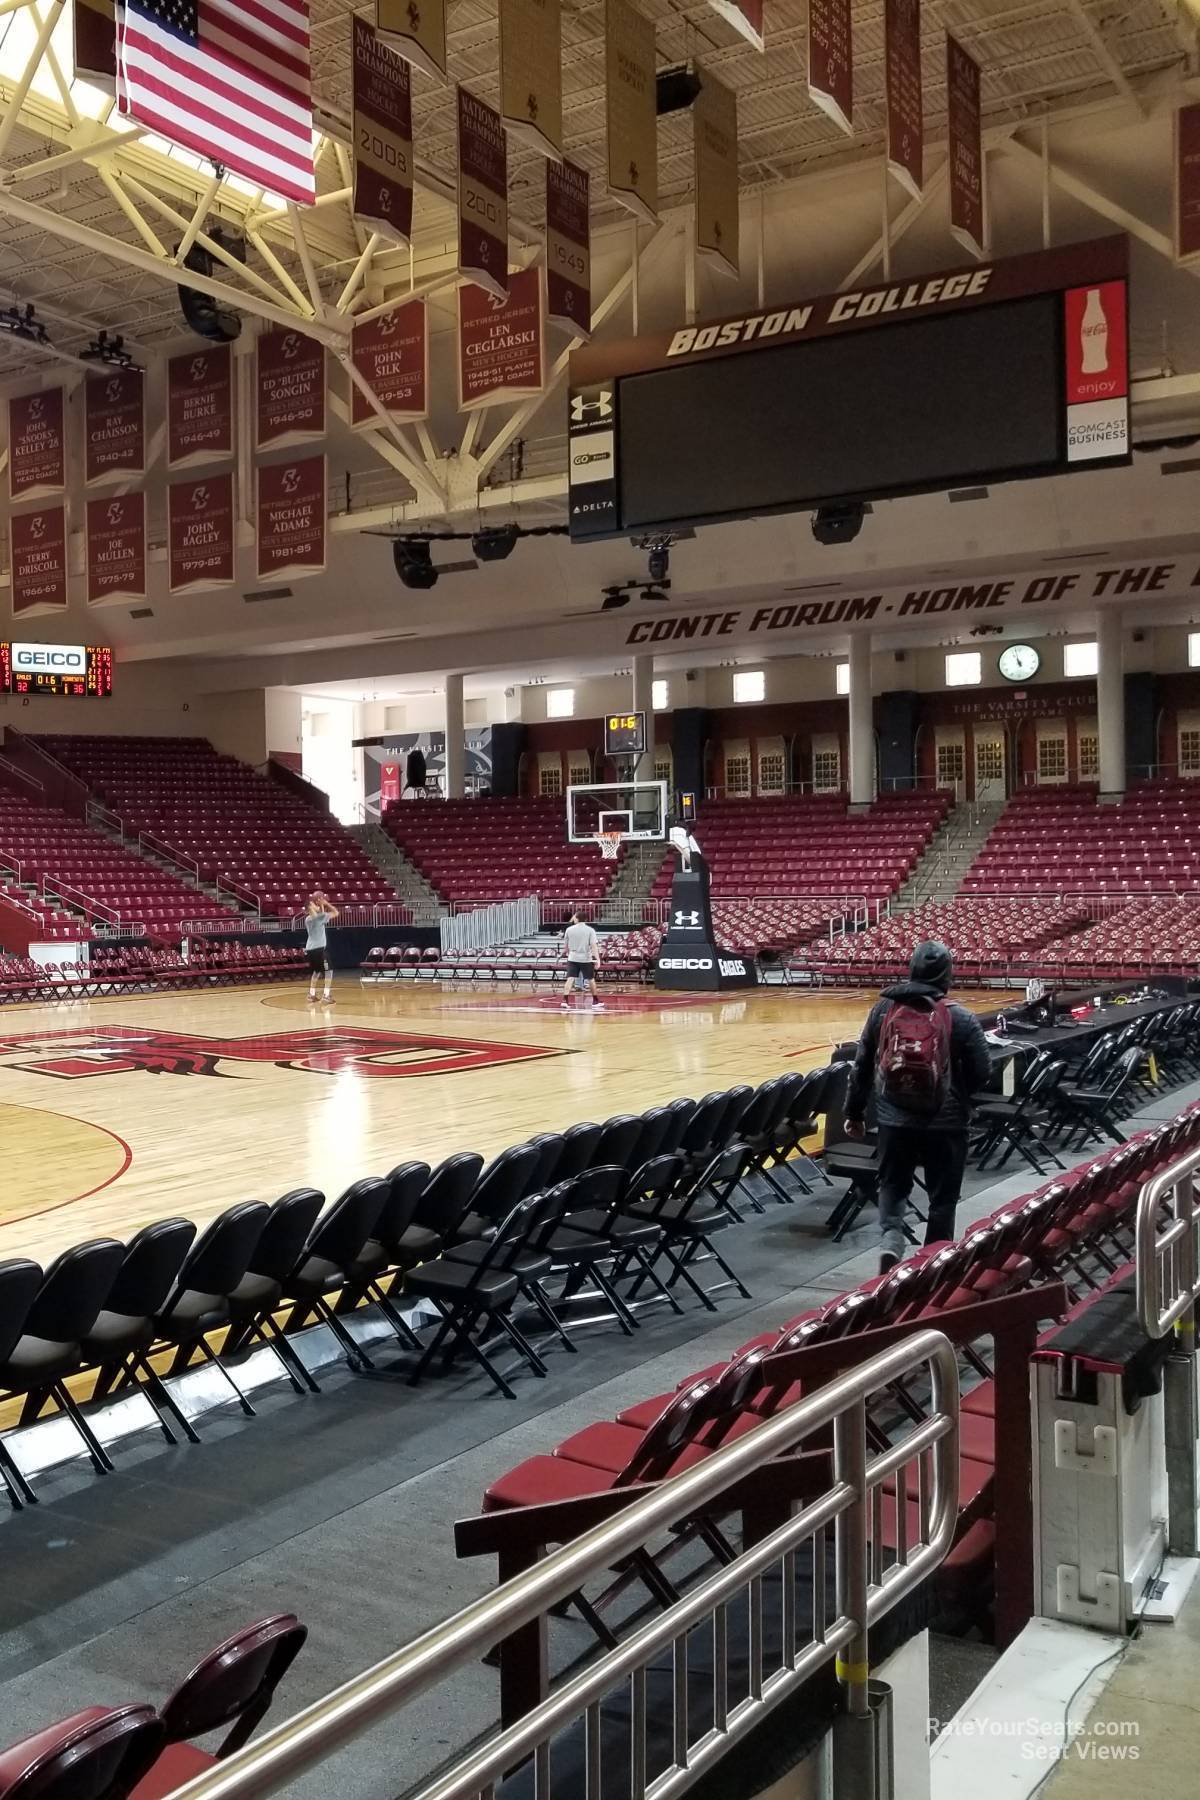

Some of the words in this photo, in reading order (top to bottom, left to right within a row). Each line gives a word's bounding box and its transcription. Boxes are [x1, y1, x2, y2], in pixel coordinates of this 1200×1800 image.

[357, 27, 408, 74] NATIONAL
[356, 47, 408, 90] CHAMPIONS
[361, 129, 406, 173] 2008
[554, 243, 585, 274] 1949
[464, 315, 500, 329] RETIRED
[502, 306, 536, 320] JERSEY
[667, 306, 813, 357] BOSTON
[828, 269, 993, 325] COLLEGE
[489, 324, 510, 339] LEN
[466, 330, 536, 356] CEGLARSKI
[374, 350, 402, 366] JOHN
[504, 360, 535, 372] PLAYER
[375, 363, 400, 378] SILK
[507, 369, 535, 381] COACH
[263, 379, 276, 391] ED
[278, 368, 319, 386] "BUTCH"
[1078, 380, 1117, 394] enjoy
[270, 382, 311, 401] SONGIN
[184, 392, 216, 409] BERNIE
[183, 404, 216, 421] BURKE
[270, 409, 313, 426] 1946-50
[26, 420, 47, 433] JOHN
[106, 416, 122, 428] RAY
[1069, 419, 1126, 435] COMCAST
[91, 423, 138, 442] CHAISSON
[179, 429, 220, 445] 1946-49
[1069, 430, 1126, 446] BUSINESS
[15, 442, 45, 457] KELLEY
[96, 449, 134, 464] 1940-42
[574, 454, 589, 465] GO
[16, 474, 35, 483] HEAD
[35, 469, 58, 479] COACH
[270, 505, 313, 522] MICHAEL
[583, 501, 614, 513] DELTA
[187, 521, 214, 536] JOHN
[273, 516, 311, 534] ADAMS
[108, 539, 123, 550] JOE
[183, 531, 220, 547] BAGLEY
[26, 551, 51, 564] TERRY
[97, 547, 135, 563] MULLEN
[271, 543, 311, 558] 1981-85
[19, 560, 59, 576] DRISCOLL
[182, 556, 222, 570] 1979-82
[98, 572, 135, 585] 1975-79
[21, 584, 57, 598] 1966-69
[626, 611, 741, 645] CONTE
[749, 595, 882, 632] FORUM
[897, 581, 1015, 617] HOME
[1022, 574, 1080, 604] OF
[1092, 564, 1176, 598] THE
[17, 651, 81, 667] GEICO
[17, 682, 28, 692] 32
[73, 684, 84, 694] 36
[953, 703, 981, 714] THE
[988, 699, 1049, 711] VARSITY
[409, 744, 444, 753] VARSIT
[659, 958, 713, 970] GEICO
[717, 958, 747, 977] EAGLES
